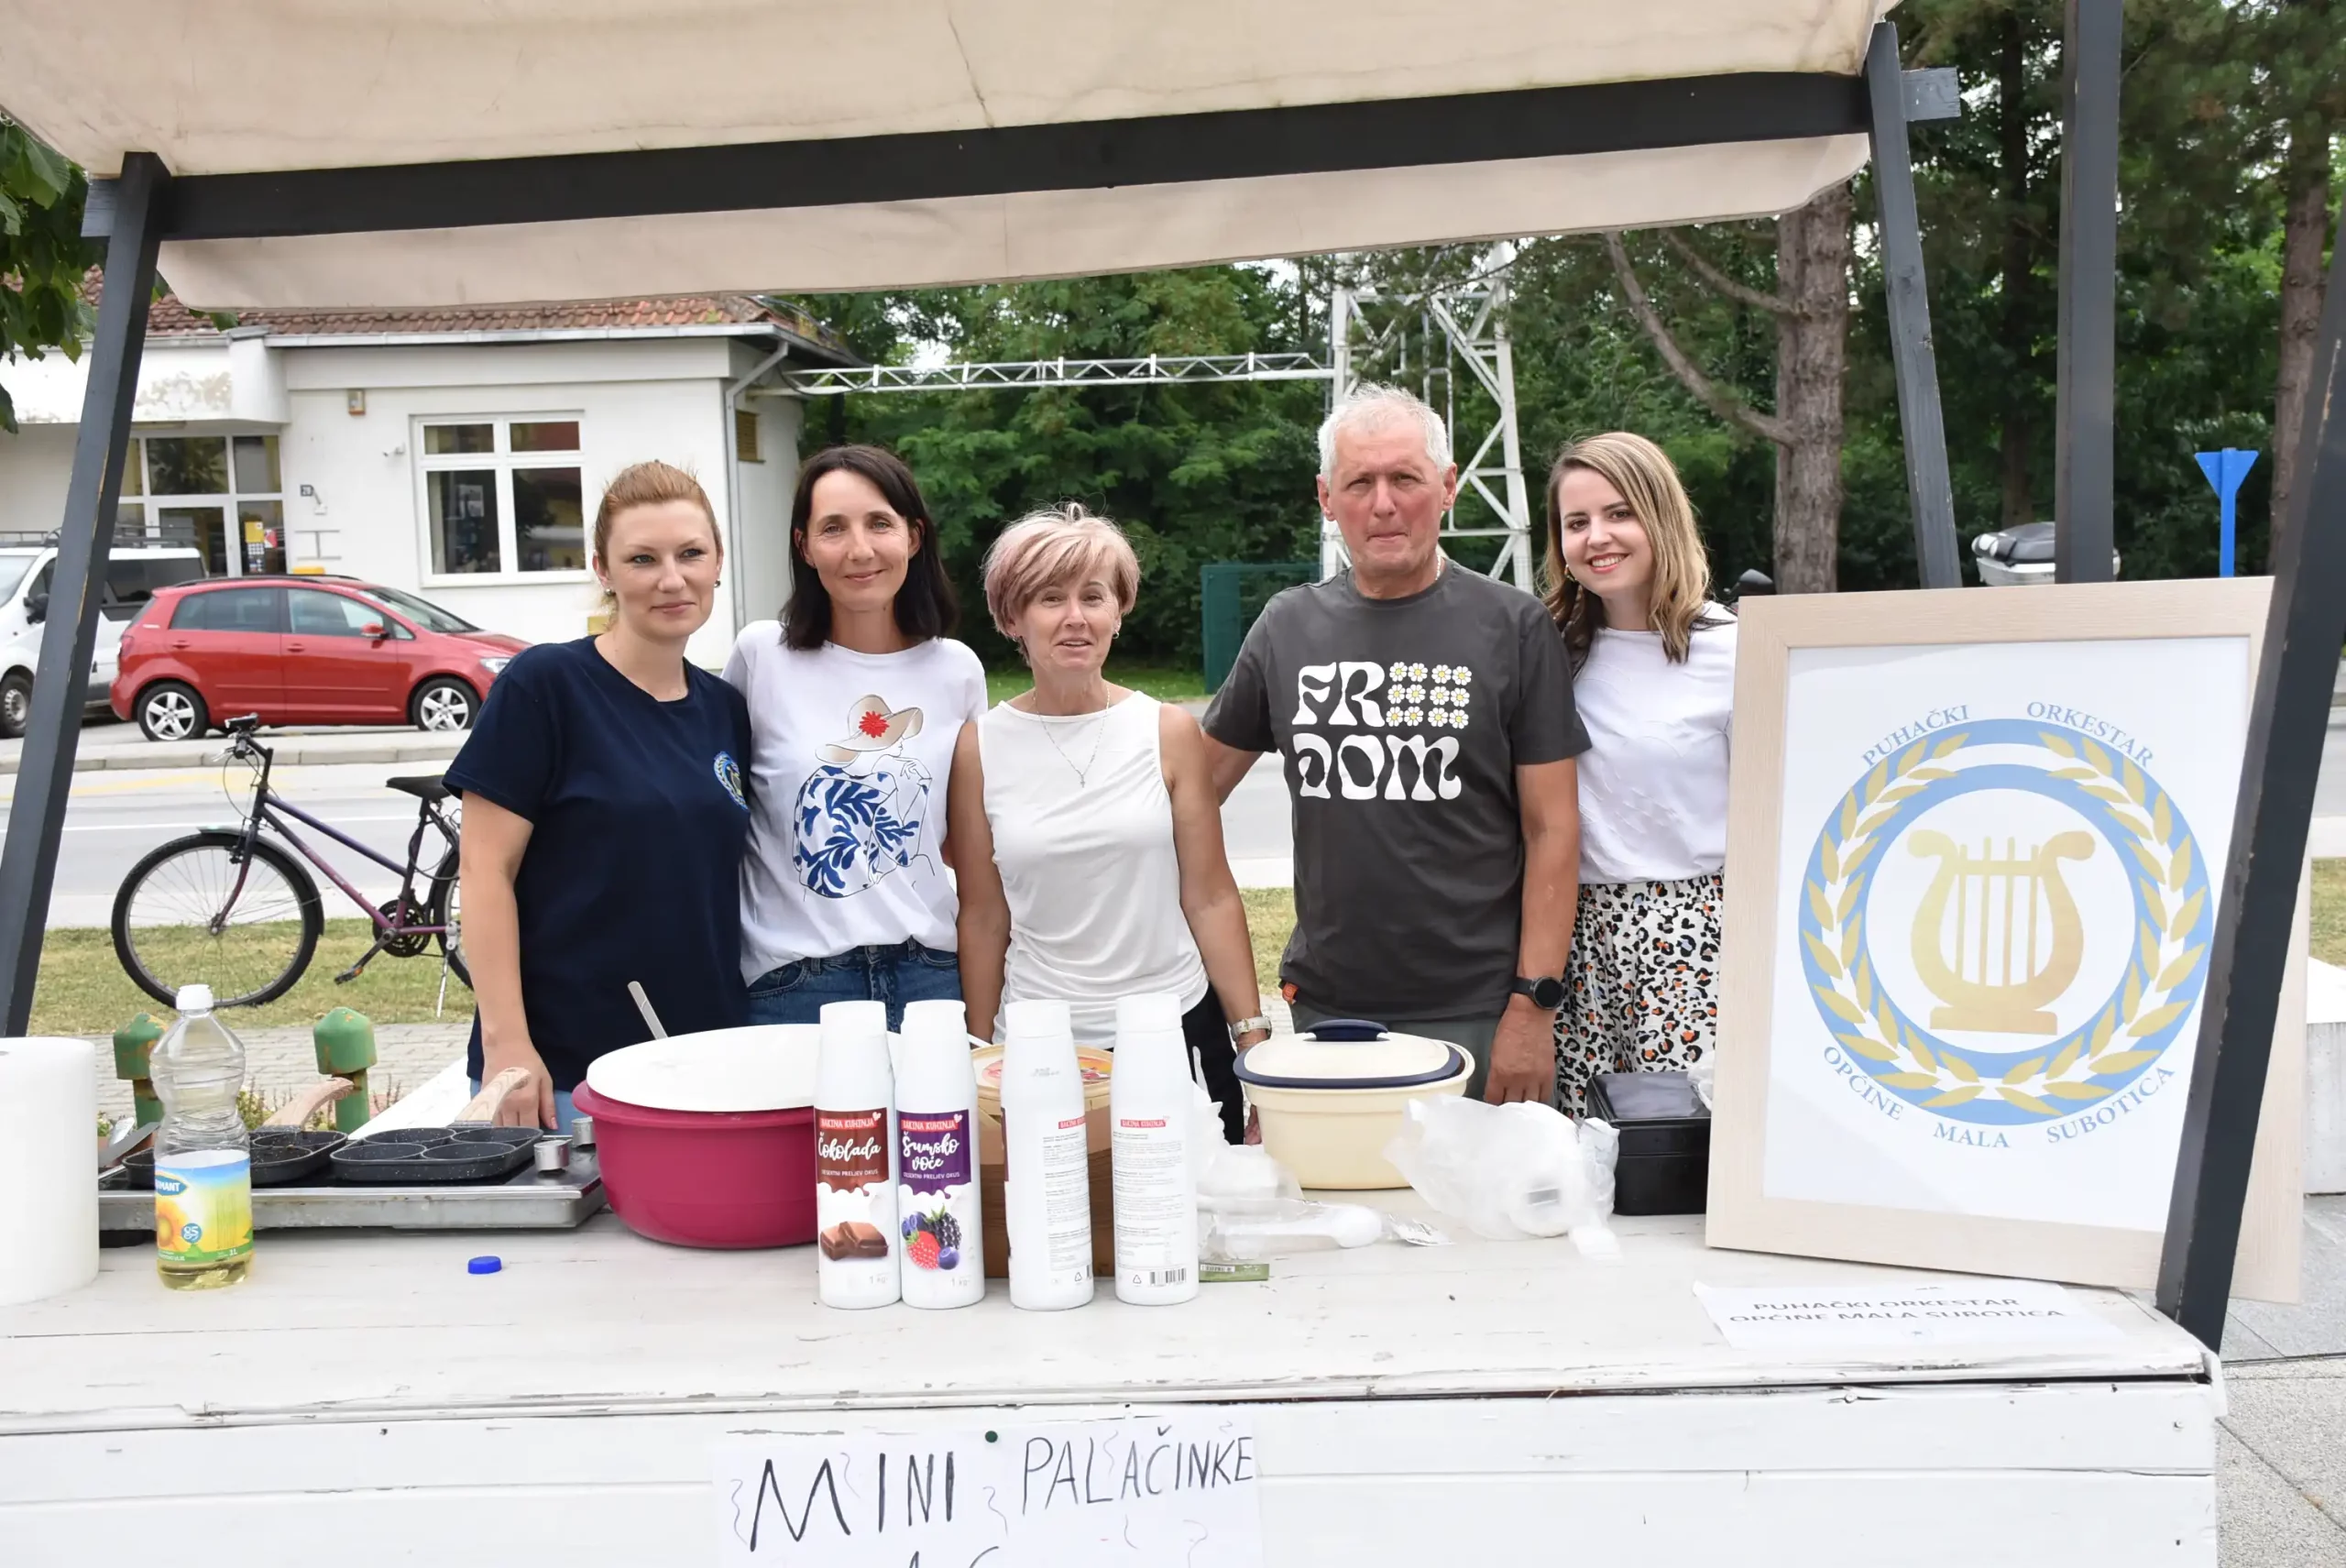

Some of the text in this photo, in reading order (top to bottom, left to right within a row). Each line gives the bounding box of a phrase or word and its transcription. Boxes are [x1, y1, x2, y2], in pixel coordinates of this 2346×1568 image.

[1861, 701, 2154, 768] PUHAČKI ORKESTAR
[1824, 1046, 2175, 1149] OPĆINE MALA SUBOTICA
[818, 1131, 882, 1162] Čokolada
[903, 1131, 959, 1157] Šumsko
[912, 1156, 944, 1170] voće
[1752, 1299, 2020, 1310] PUHAČKI ORKESTAR
[1837, 1311, 1918, 1320] MALA
[1925, 1310, 2066, 1319] SUBOTICA
[750, 1426, 1254, 1552] MINI PALAČINKE
